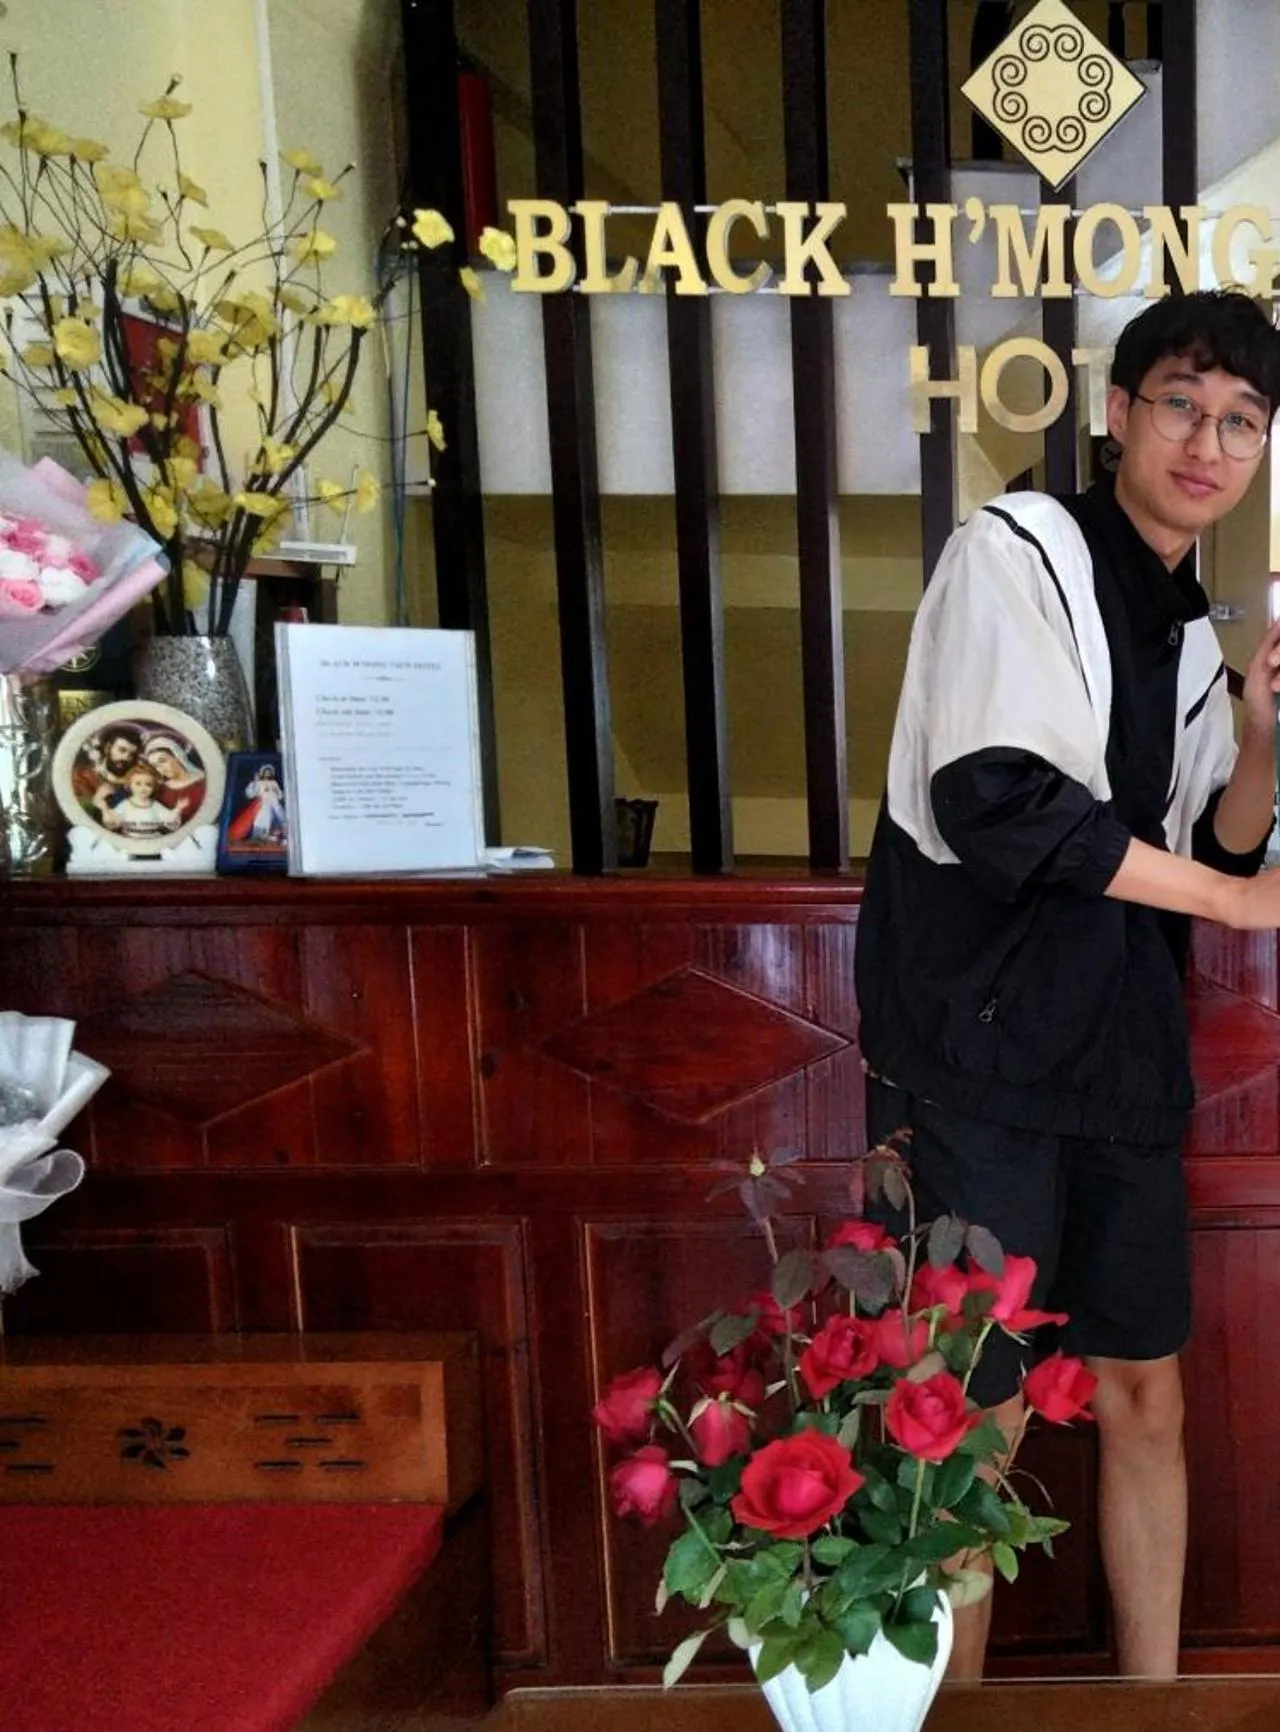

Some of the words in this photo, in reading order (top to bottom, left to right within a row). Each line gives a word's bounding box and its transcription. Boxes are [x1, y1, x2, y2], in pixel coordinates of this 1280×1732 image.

[507, 198, 852, 296] BLACK
[887, 196, 1280, 299] H'MONG
[910, 336, 1115, 436] HOT
